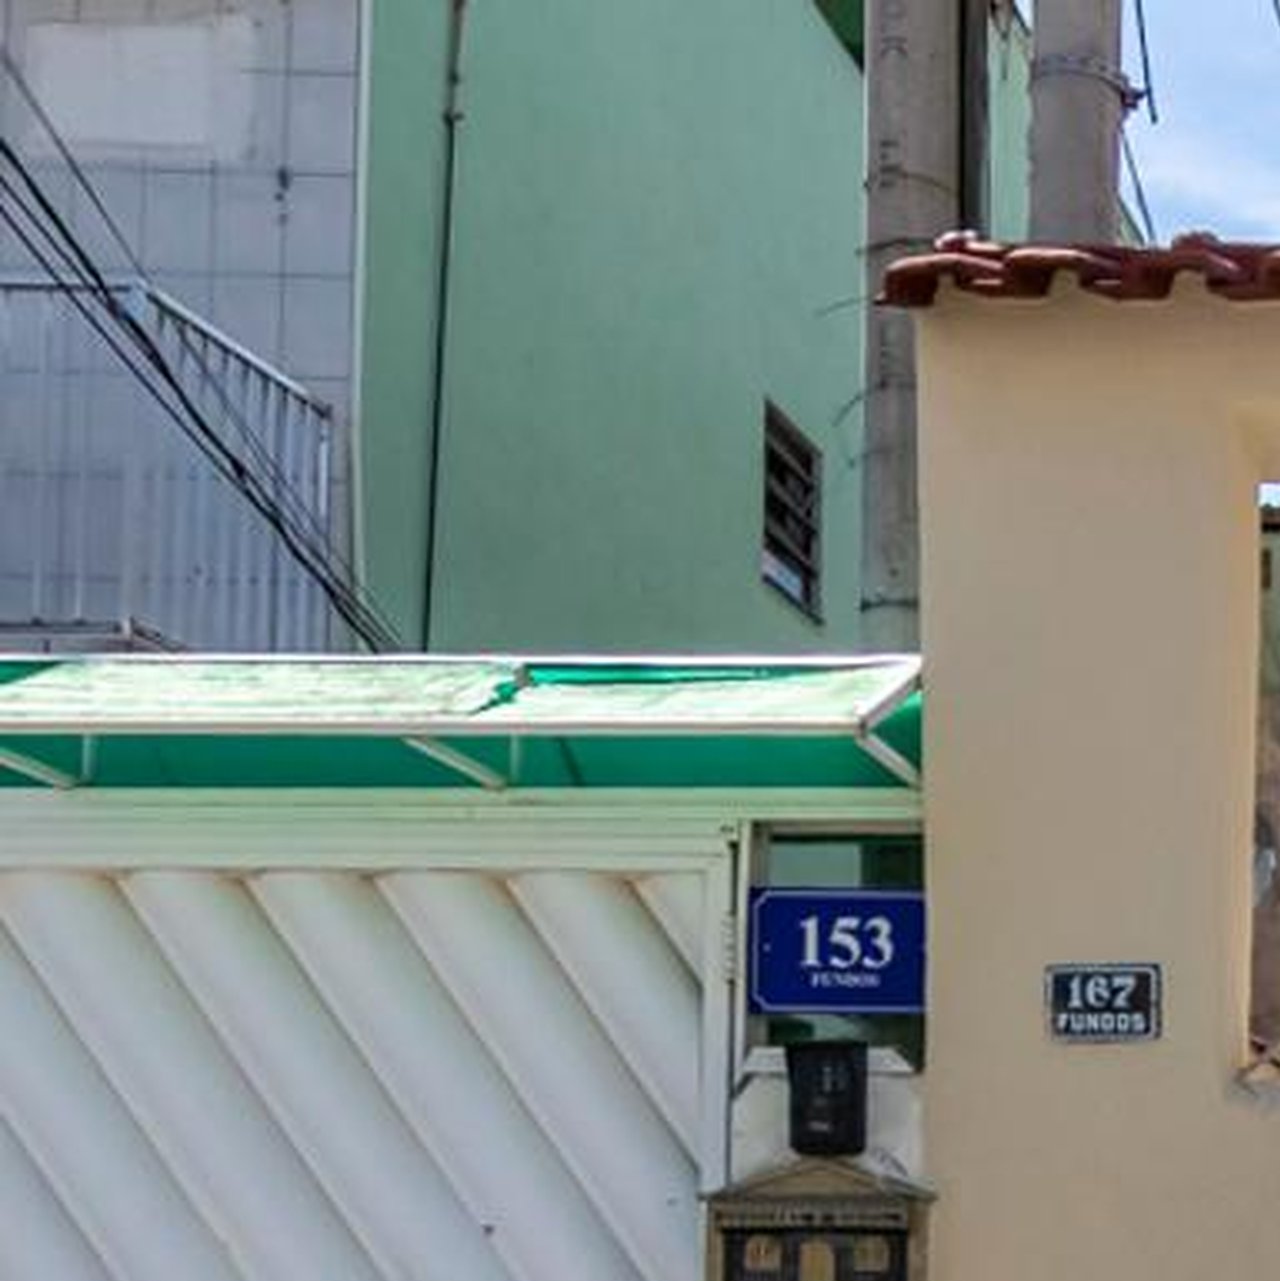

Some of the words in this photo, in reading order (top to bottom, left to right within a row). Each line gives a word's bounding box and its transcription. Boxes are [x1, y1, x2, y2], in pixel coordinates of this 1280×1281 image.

[800, 915, 895, 969] 153
[1067, 974, 1136, 1009] 167
[1057, 1012, 1145, 1032] FUNDOS
